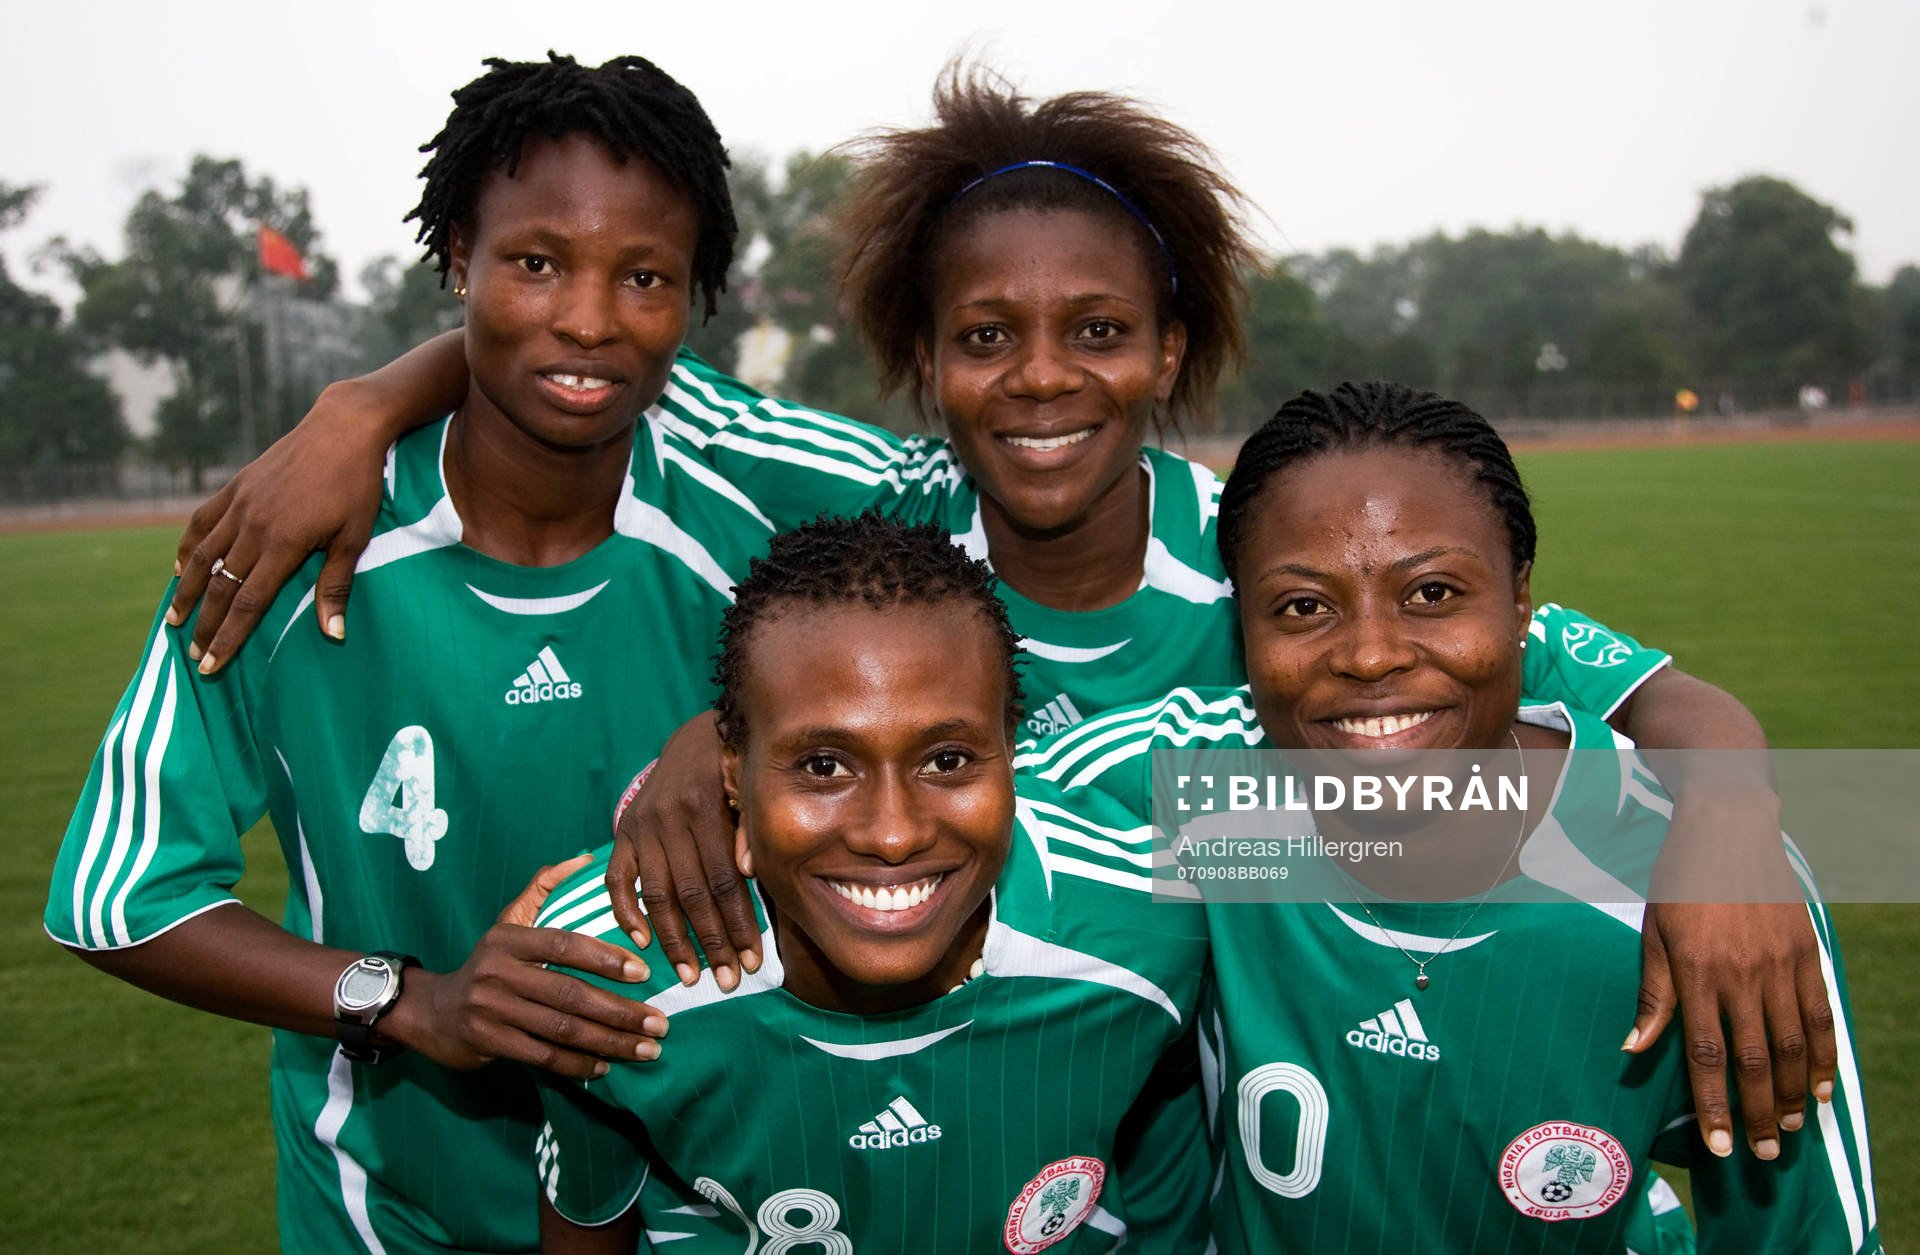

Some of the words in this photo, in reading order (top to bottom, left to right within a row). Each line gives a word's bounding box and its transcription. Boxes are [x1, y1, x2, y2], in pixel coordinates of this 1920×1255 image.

[505, 681, 582, 705] adidas
[359, 725, 448, 871] 4
[1346, 1030, 1440, 1061] adidas
[849, 1124, 942, 1150] adidas
[1020, 1161, 1077, 1204] FOOTBALL
[1503, 1143, 1525, 1189] NIGERIA
[1523, 1126, 1597, 1145] FOOTBALL
[1598, 1139, 1627, 1209] ASSOCIATION
[1524, 1206, 1571, 1218] ABUJA
